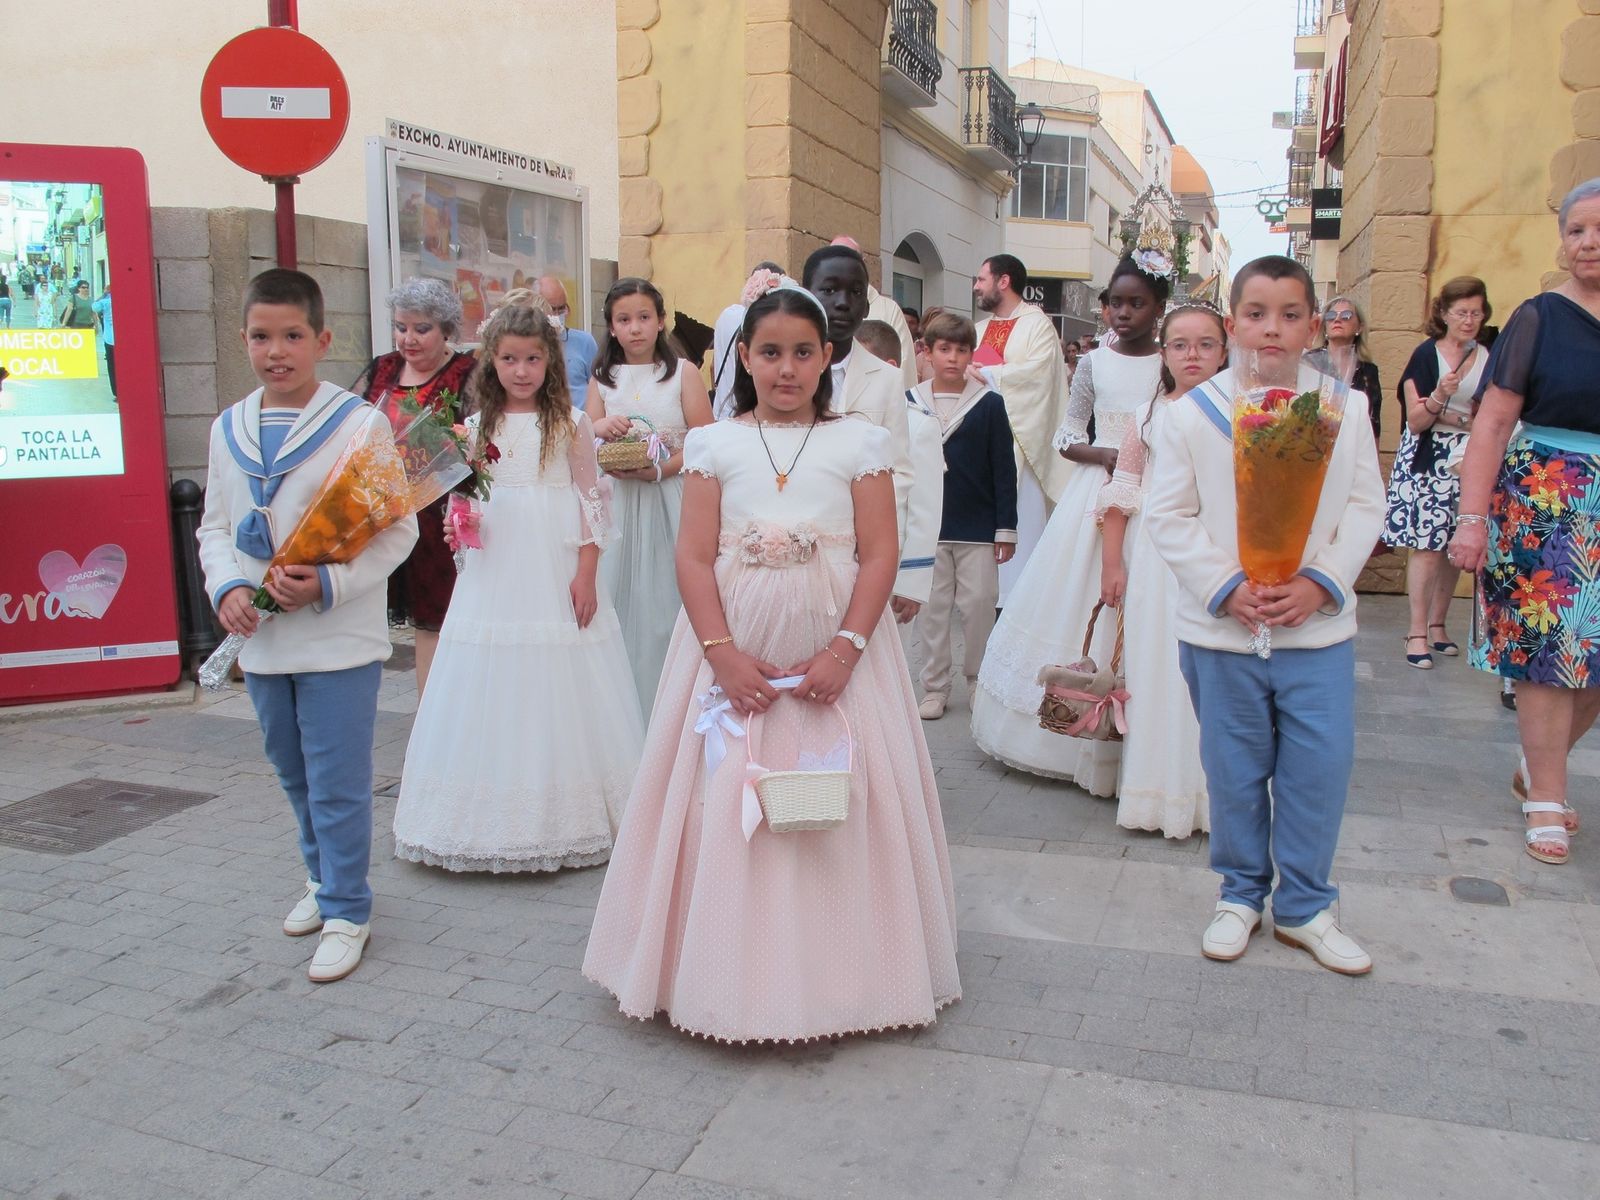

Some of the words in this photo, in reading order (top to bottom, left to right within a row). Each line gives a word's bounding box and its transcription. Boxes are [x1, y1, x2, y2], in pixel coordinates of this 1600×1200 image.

[398, 124, 444, 149] EXCMO.
[448, 138, 527, 169] AYUNTAMIENTO
[530, 158, 541, 173] DE
[0, 331, 83, 350] MERCIO
[0, 357, 64, 376] OCAL
[22, 430, 67, 445] TOCA
[73, 429, 92, 443] LA
[16, 446, 101, 462] PANTALLA
